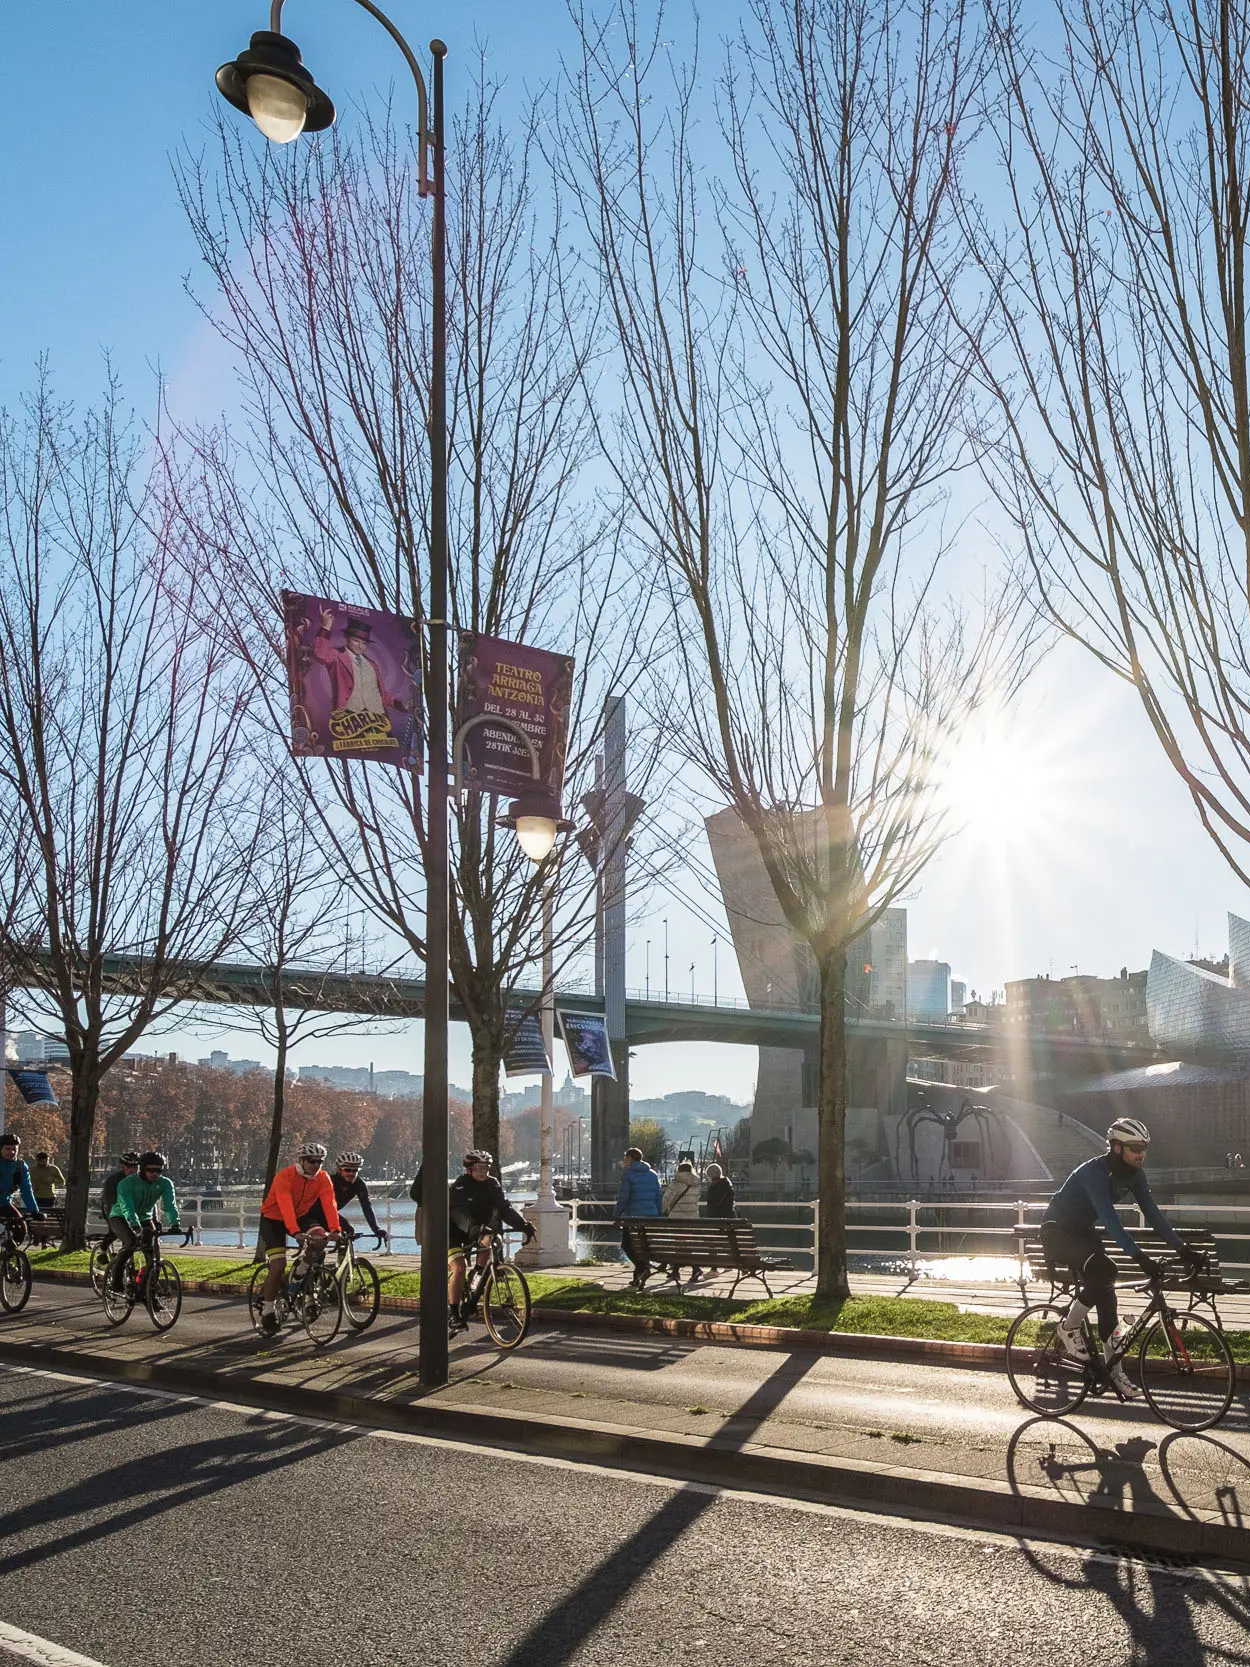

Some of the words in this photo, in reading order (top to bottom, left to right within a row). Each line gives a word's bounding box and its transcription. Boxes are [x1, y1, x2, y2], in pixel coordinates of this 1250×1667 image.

[495, 662, 542, 682] TEATRO
[491, 673, 543, 695] ARRIAGA
[487, 684, 545, 706] ANTZOKIA
[484, 702, 503, 715] DEL
[505, 707, 517, 717] 28
[519, 710, 532, 721] AL
[534, 713, 545, 723] 30
[485, 740, 512, 753] 28TIK
